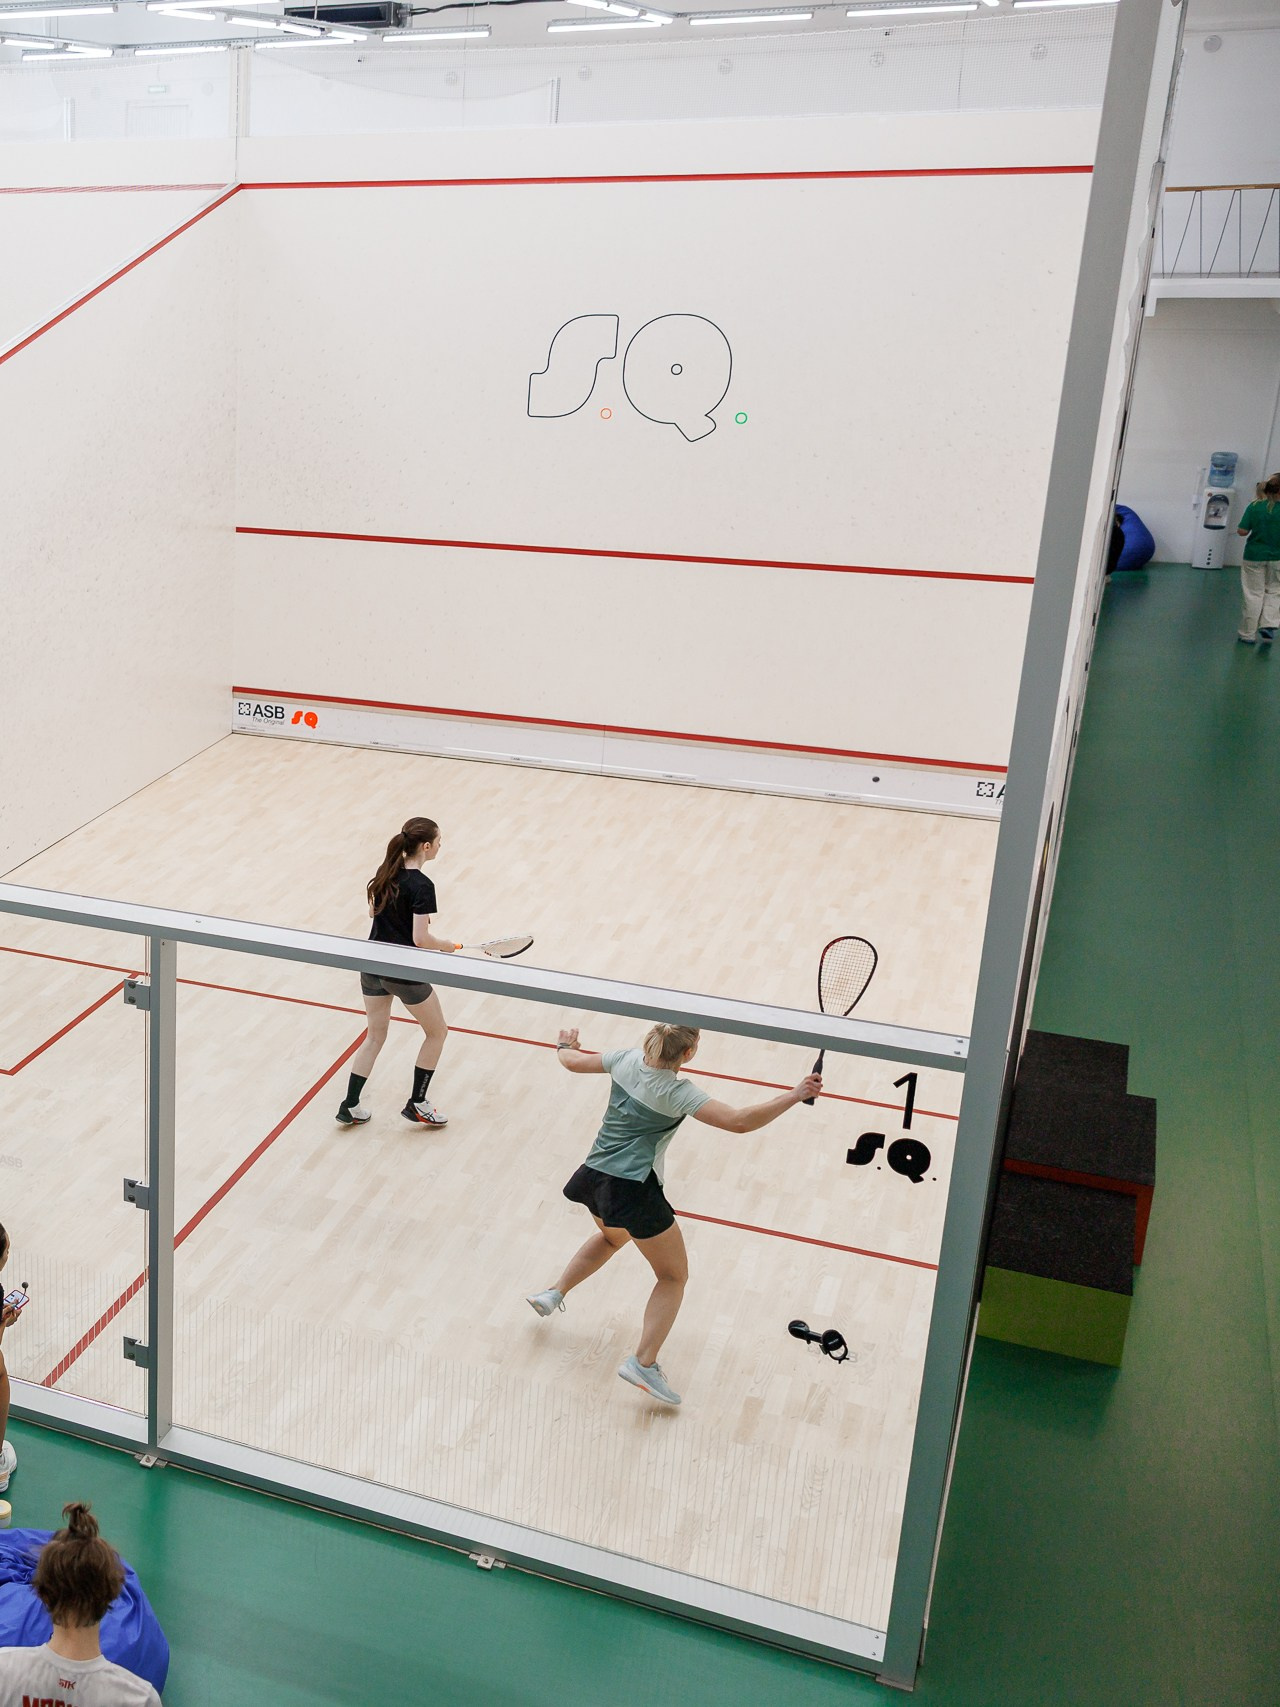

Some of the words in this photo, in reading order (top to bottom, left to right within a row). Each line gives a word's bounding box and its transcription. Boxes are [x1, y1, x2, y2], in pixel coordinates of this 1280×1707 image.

[253, 704, 285, 719] ASB
[893, 1072, 918, 1130] 1
[0, 1154, 23, 1168] ASB
